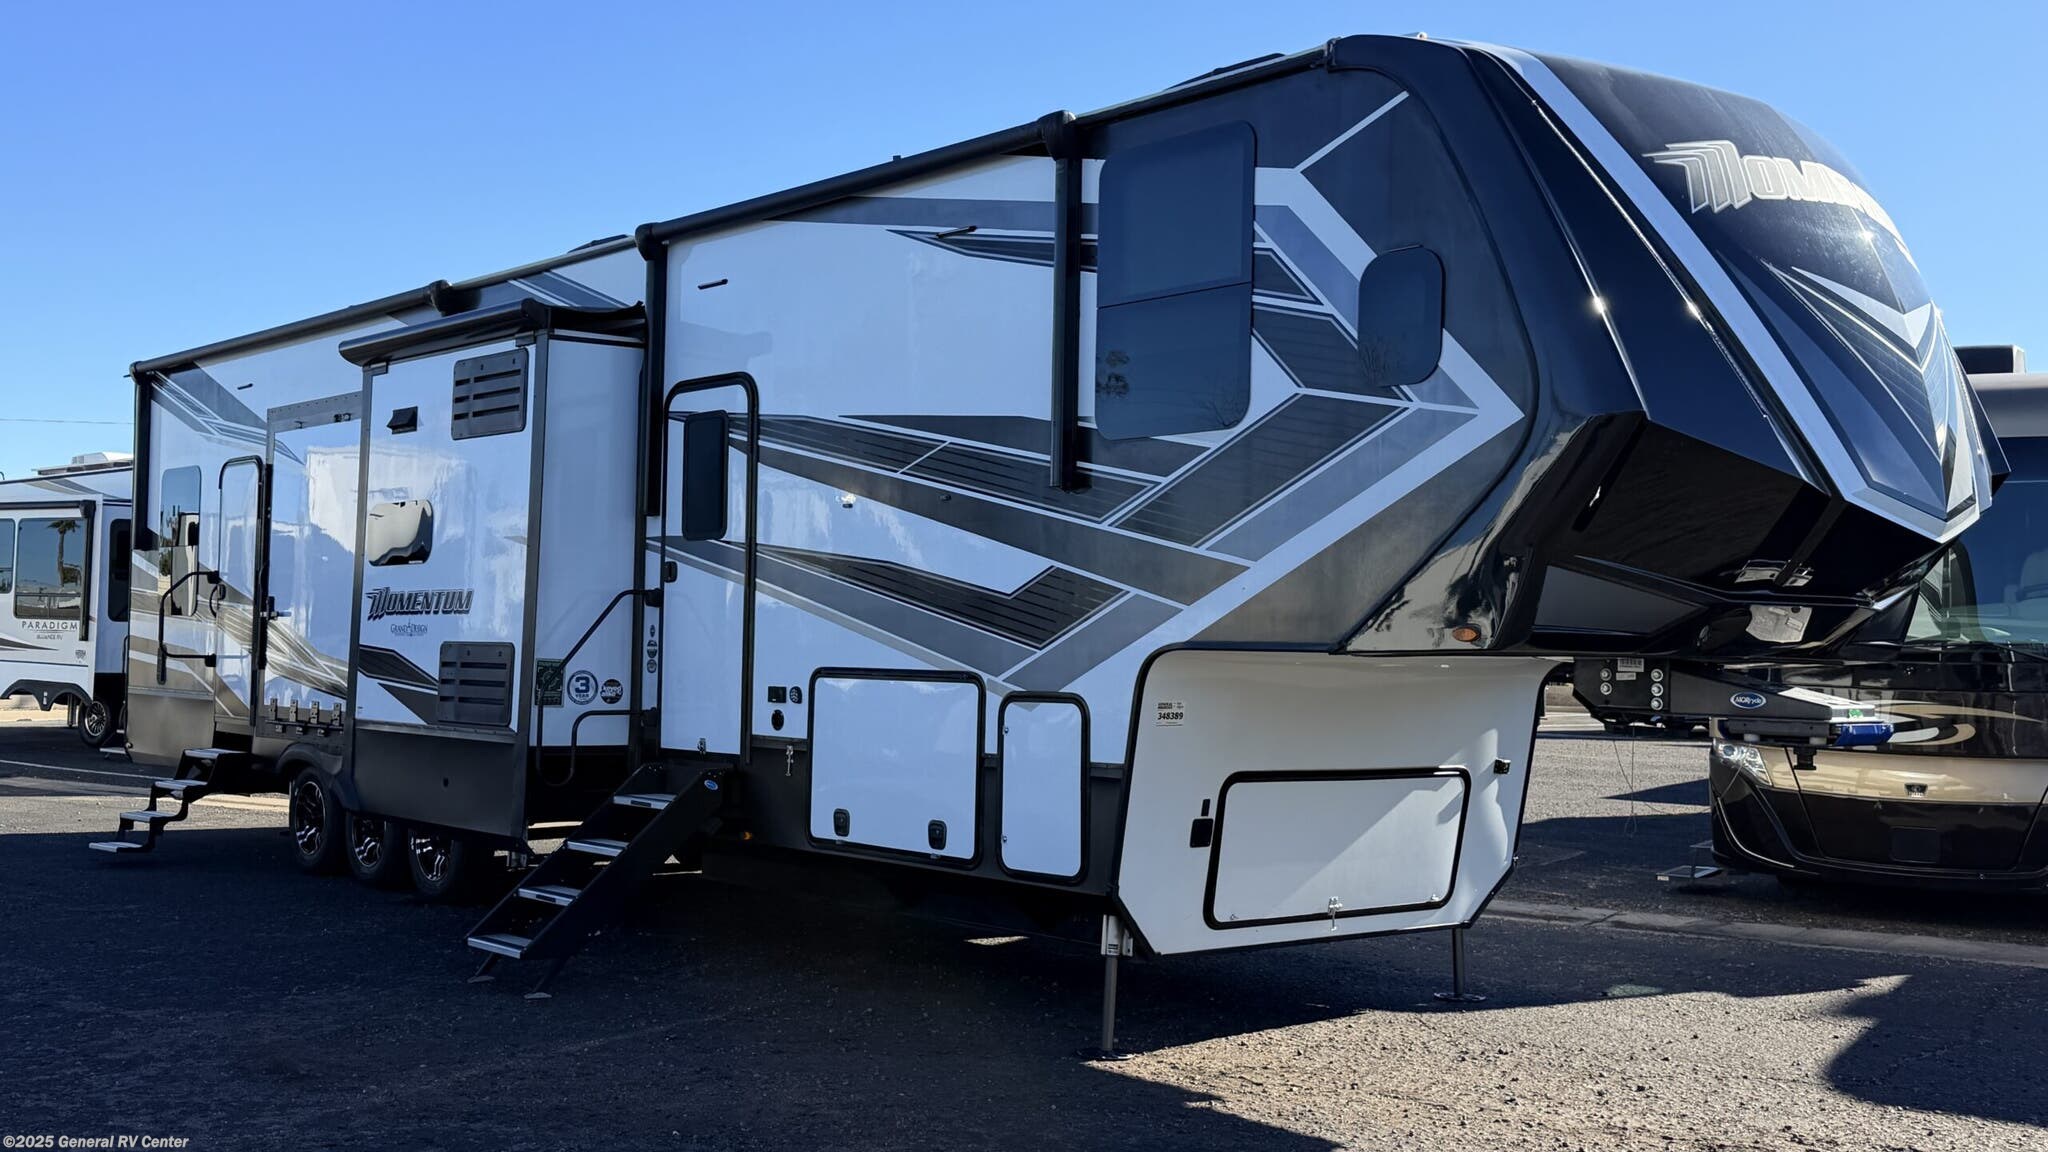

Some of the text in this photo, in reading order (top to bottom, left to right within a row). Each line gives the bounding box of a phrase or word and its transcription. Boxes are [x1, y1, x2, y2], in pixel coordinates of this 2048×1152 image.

[365, 586, 474, 621] MOMENTUM
[22, 621, 78, 630] PARADIGM
[575, 676, 590, 693] 3
[1157, 712, 1183, 720] 348389
